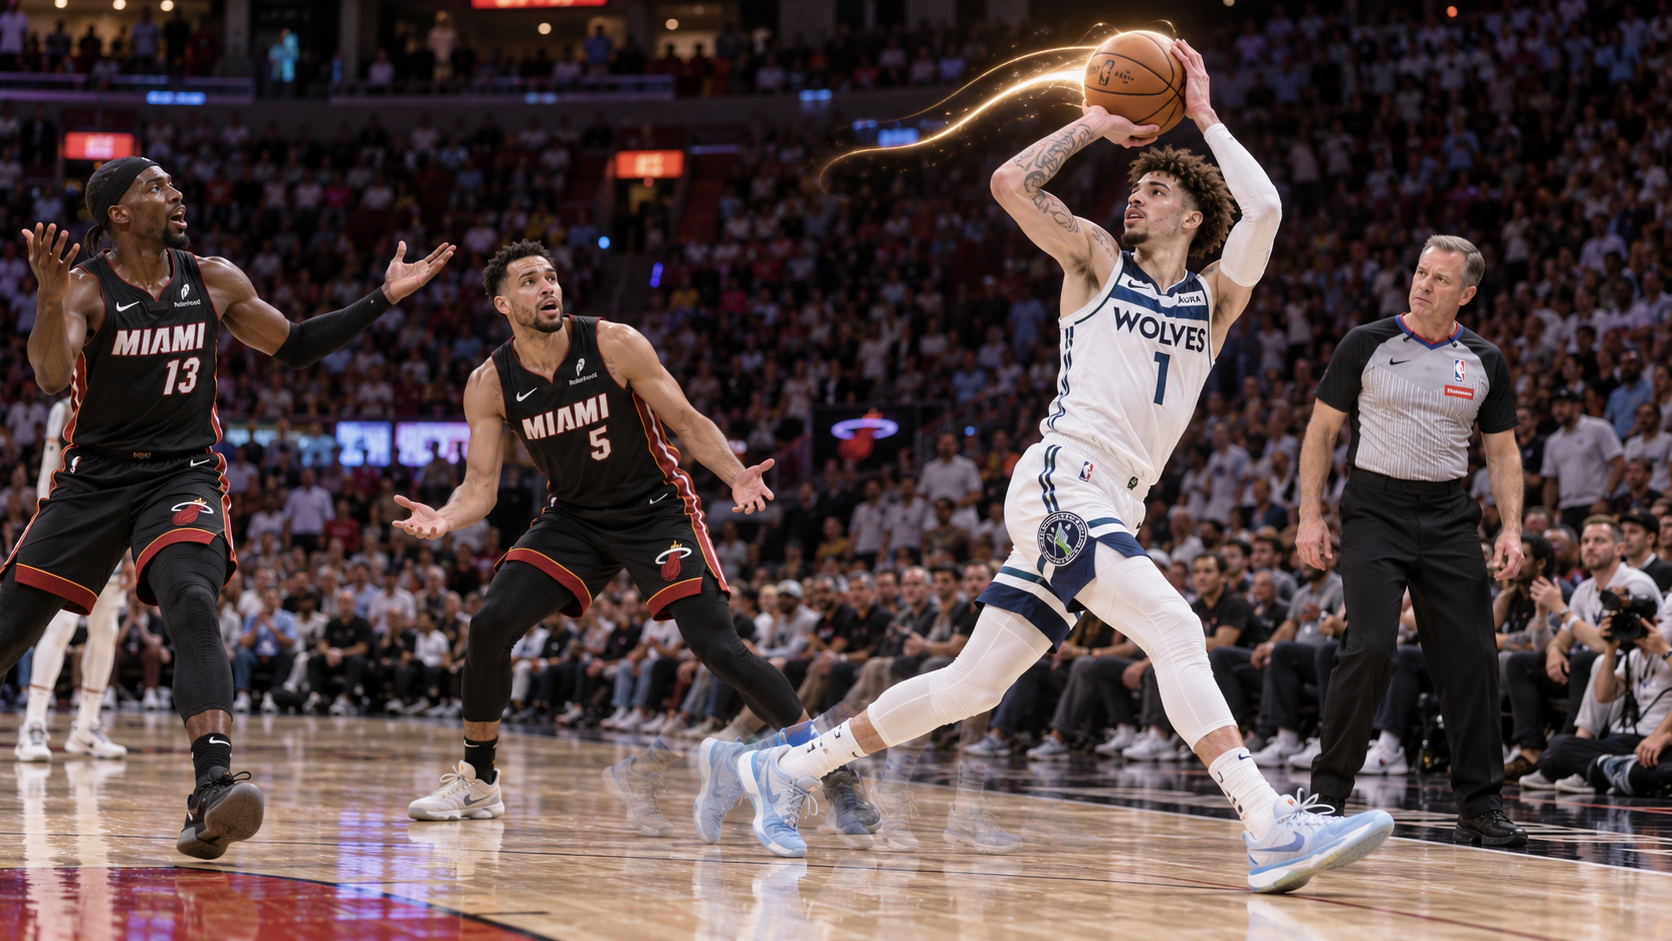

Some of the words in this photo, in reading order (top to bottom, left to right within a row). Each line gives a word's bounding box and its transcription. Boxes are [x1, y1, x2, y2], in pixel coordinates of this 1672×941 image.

[1178, 295, 1202, 305] AURA
[111, 322, 206, 356] MIAMI
[1113, 306, 1206, 353] WOLVES
[162, 356, 201, 396] 13
[1153, 351, 1171, 406] 1
[521, 392, 610, 440] MIAMI
[588, 424, 612, 461] 5
